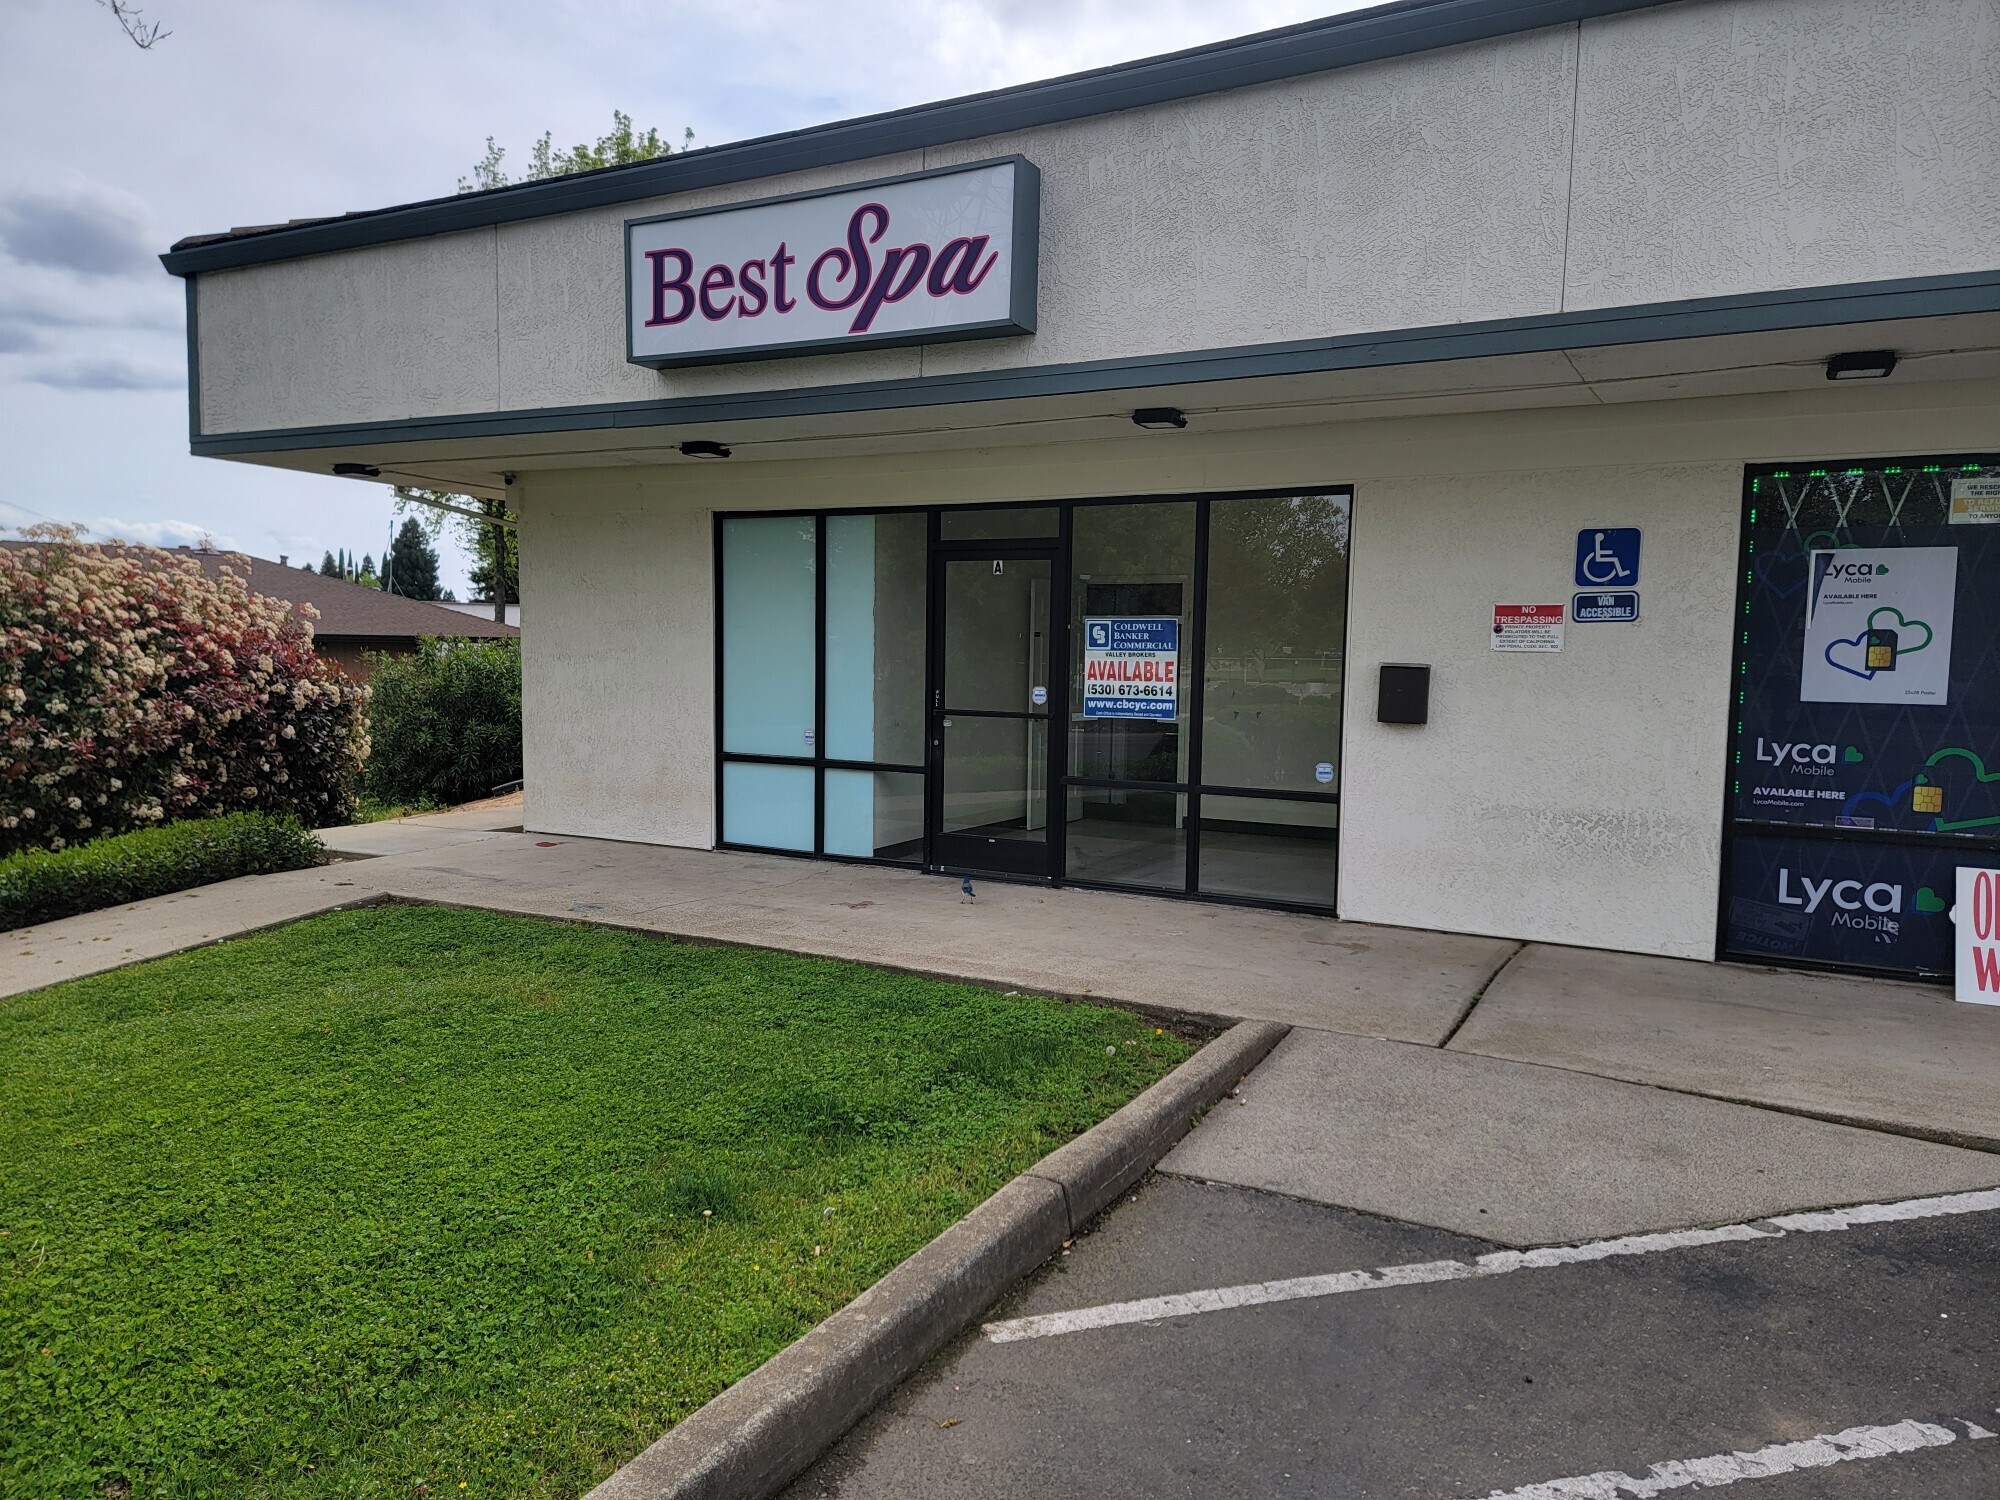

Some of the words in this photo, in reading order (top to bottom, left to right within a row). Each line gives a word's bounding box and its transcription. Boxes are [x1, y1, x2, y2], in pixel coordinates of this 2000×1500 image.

[644, 241, 797, 328] Best
[806, 202, 999, 334] Spa
[994, 561, 1002, 573] A
[1597, 596, 1615, 606] VAN
[1521, 606, 1537, 614] NO
[1580, 607, 1632, 618] ACCESSIBLE
[1495, 616, 1563, 624] TRESPASSING
[1114, 622, 1163, 631] COLDWELL
[1114, 632, 1149, 640] BANKER
[1113, 641, 1174, 649] COMMERCIAL
[1087, 660, 1174, 682] AVAILABLE
[1088, 684, 1115, 695] (530)
[1119, 685, 1173, 696] 673-6614
[1088, 699, 1173, 711] www.cbcyc.com
[1756, 737, 1837, 767] Lyca
[1790, 764, 1835, 776] Mobile
[1753, 787, 1815, 798] AVAILABLE
[1817, 790, 1846, 800] HERE
[1753, 798, 1804, 807] LycaMobile.com
[1778, 868, 1902, 914] Lyca
[1831, 911, 1900, 932] Mobile
